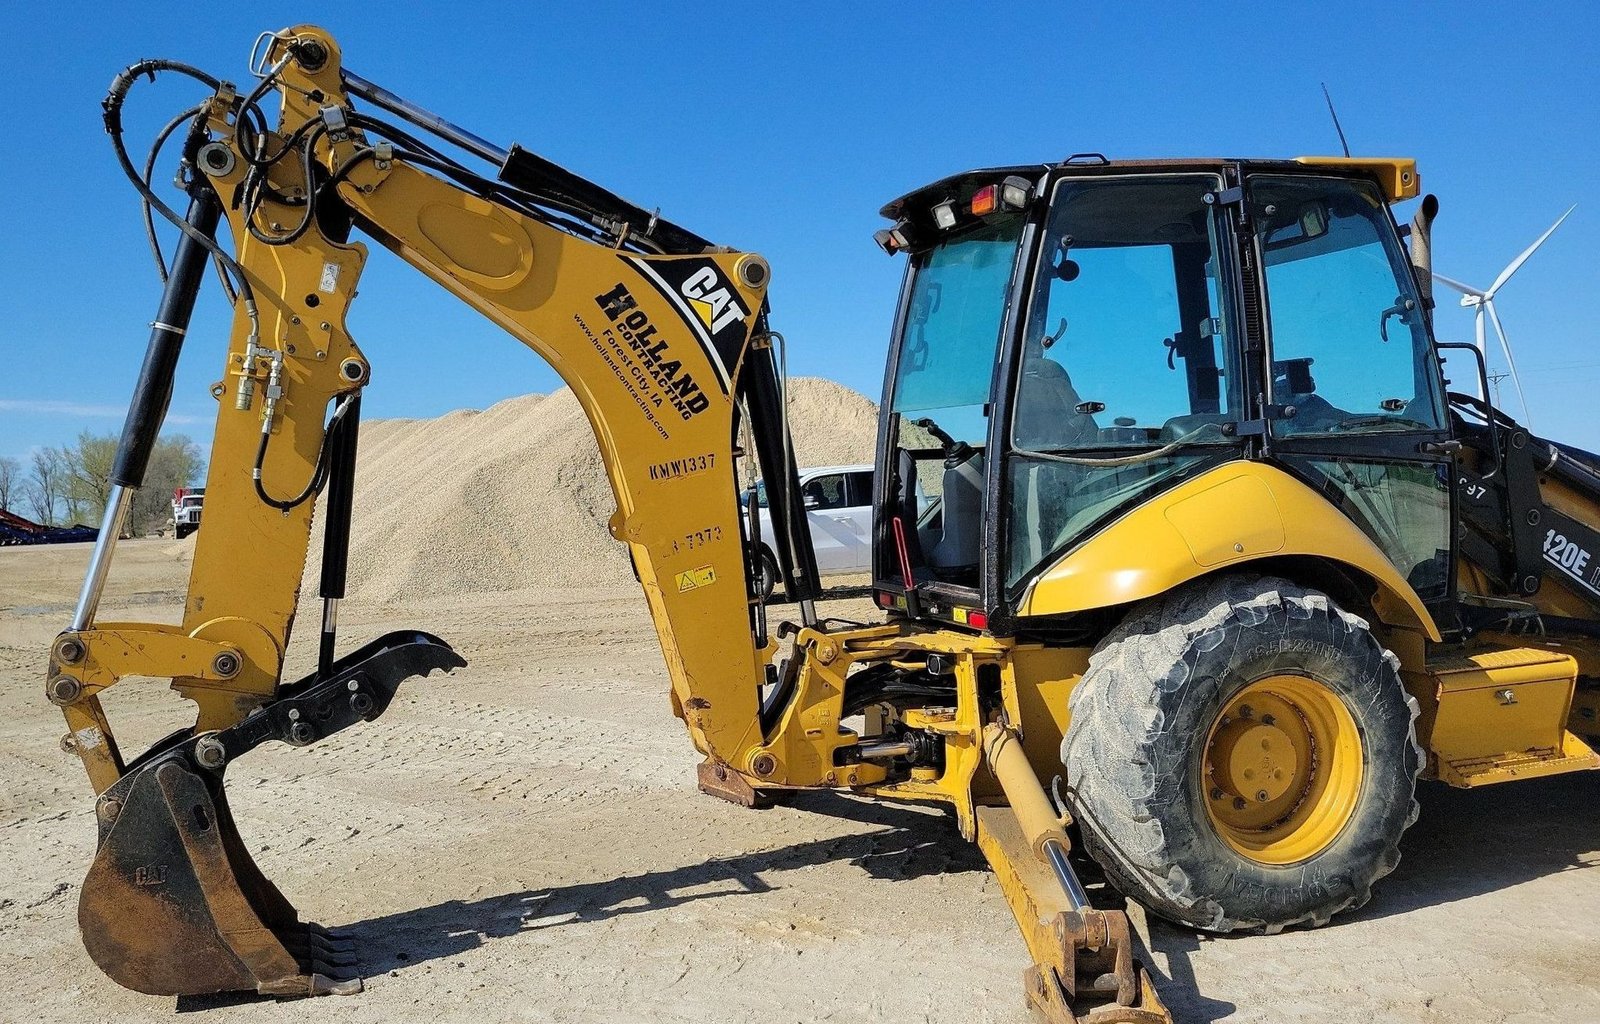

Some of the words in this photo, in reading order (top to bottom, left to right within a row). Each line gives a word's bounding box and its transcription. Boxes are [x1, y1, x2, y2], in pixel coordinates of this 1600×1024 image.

[594, 282, 710, 415] HOLLAND
[681, 266, 746, 335] CAT
[574, 313, 669, 440] www.hollandcontracting.com
[602, 328, 634, 367] Forest
[631, 365, 651, 395] City,
[649, 392, 663, 408] IA
[616, 322, 693, 421] CONTRACTING
